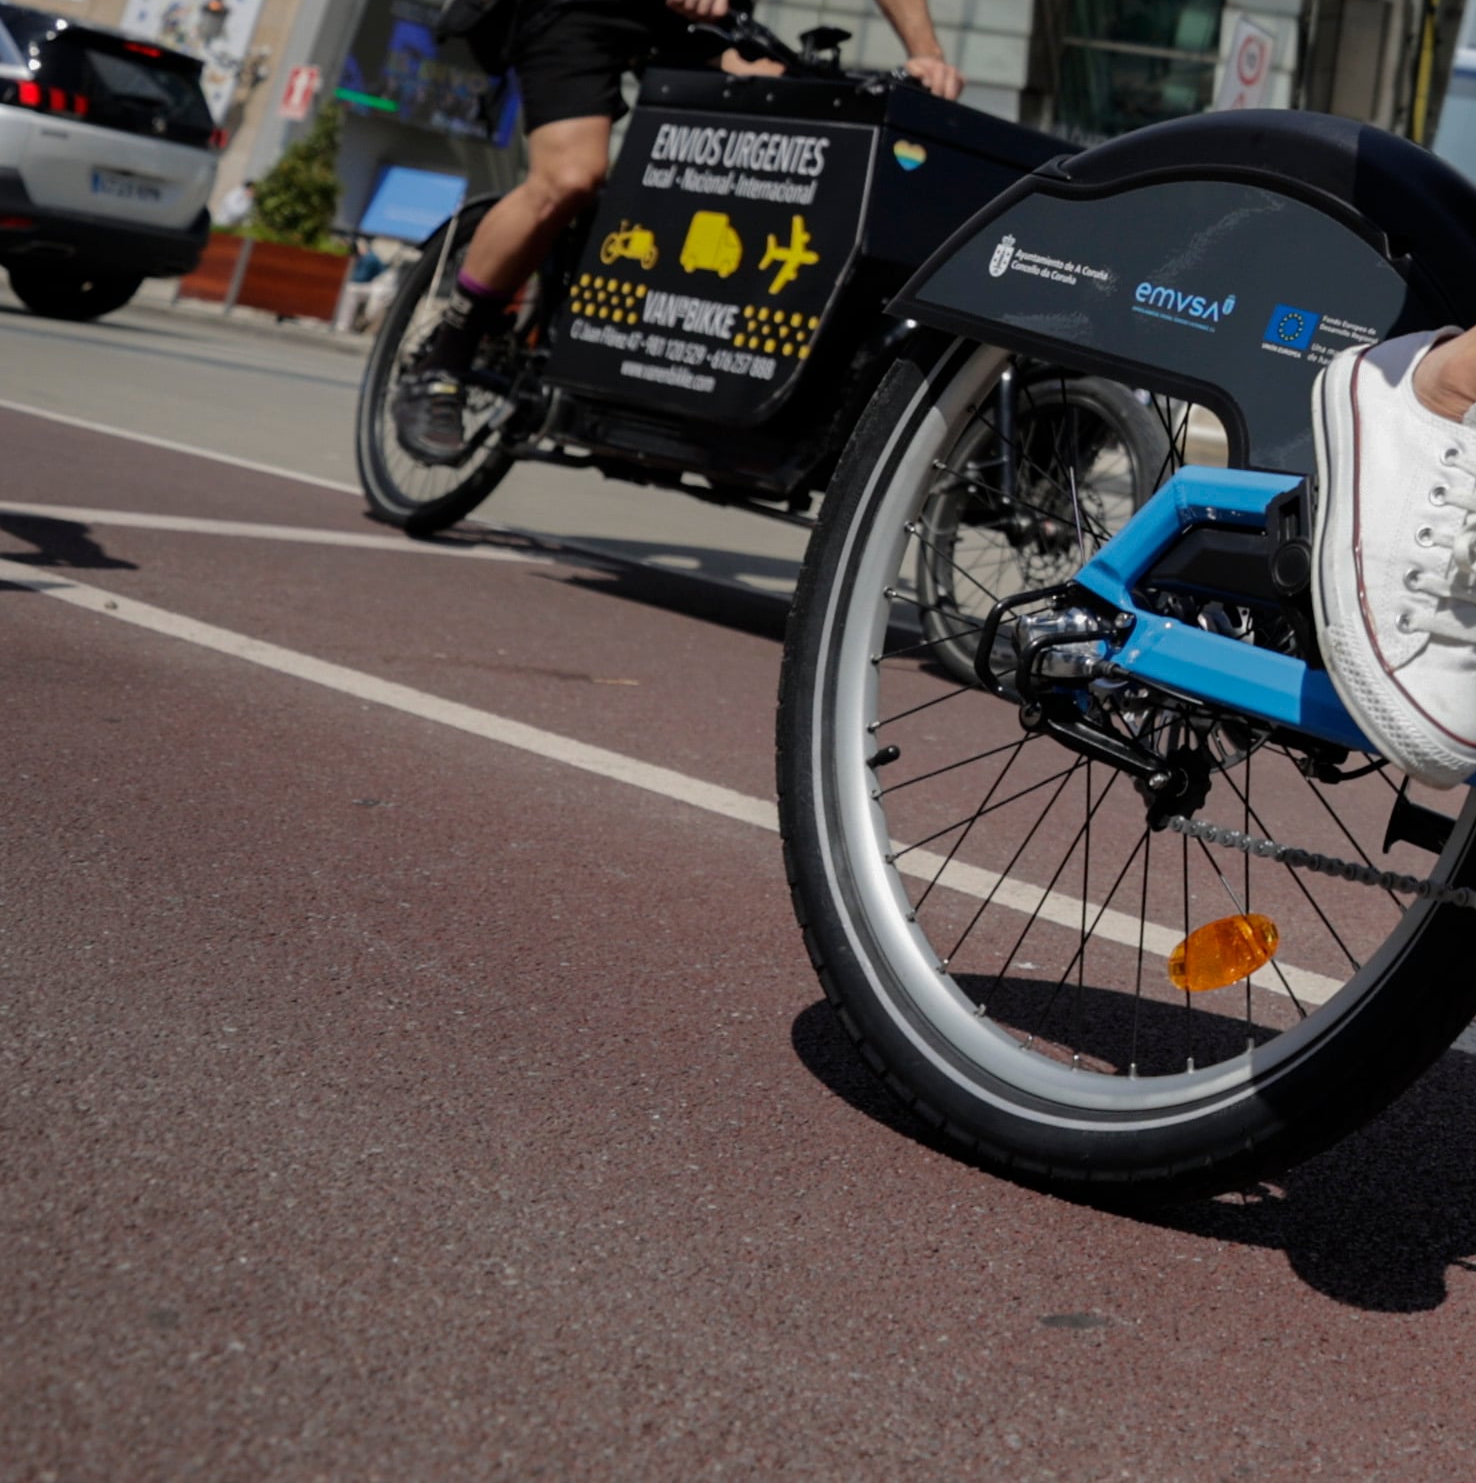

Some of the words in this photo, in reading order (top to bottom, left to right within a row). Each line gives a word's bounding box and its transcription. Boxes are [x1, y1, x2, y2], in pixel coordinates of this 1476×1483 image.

[651, 123, 727, 167] ENVIOS
[722, 130, 831, 177] URGENTES
[642, 163, 677, 189] Local
[680, 167, 735, 197] Nacional
[734, 172, 819, 206] Internacional
[1010, 259, 1041, 276] Concello
[1040, 267, 1051, 279] da
[1050, 270, 1077, 286] Coruña
[1015, 248, 1064, 270] Ayuntamiento
[1064, 261, 1075, 273] de
[1074, 264, 1082, 274] A
[1082, 265, 1109, 281] Coruña
[1321, 314, 1342, 327] Fondo
[1342, 318, 1367, 334] Europeo
[1367, 326, 1377, 336] de
[1307, 352, 1318, 362] de
[1311, 343, 1327, 355] Una
